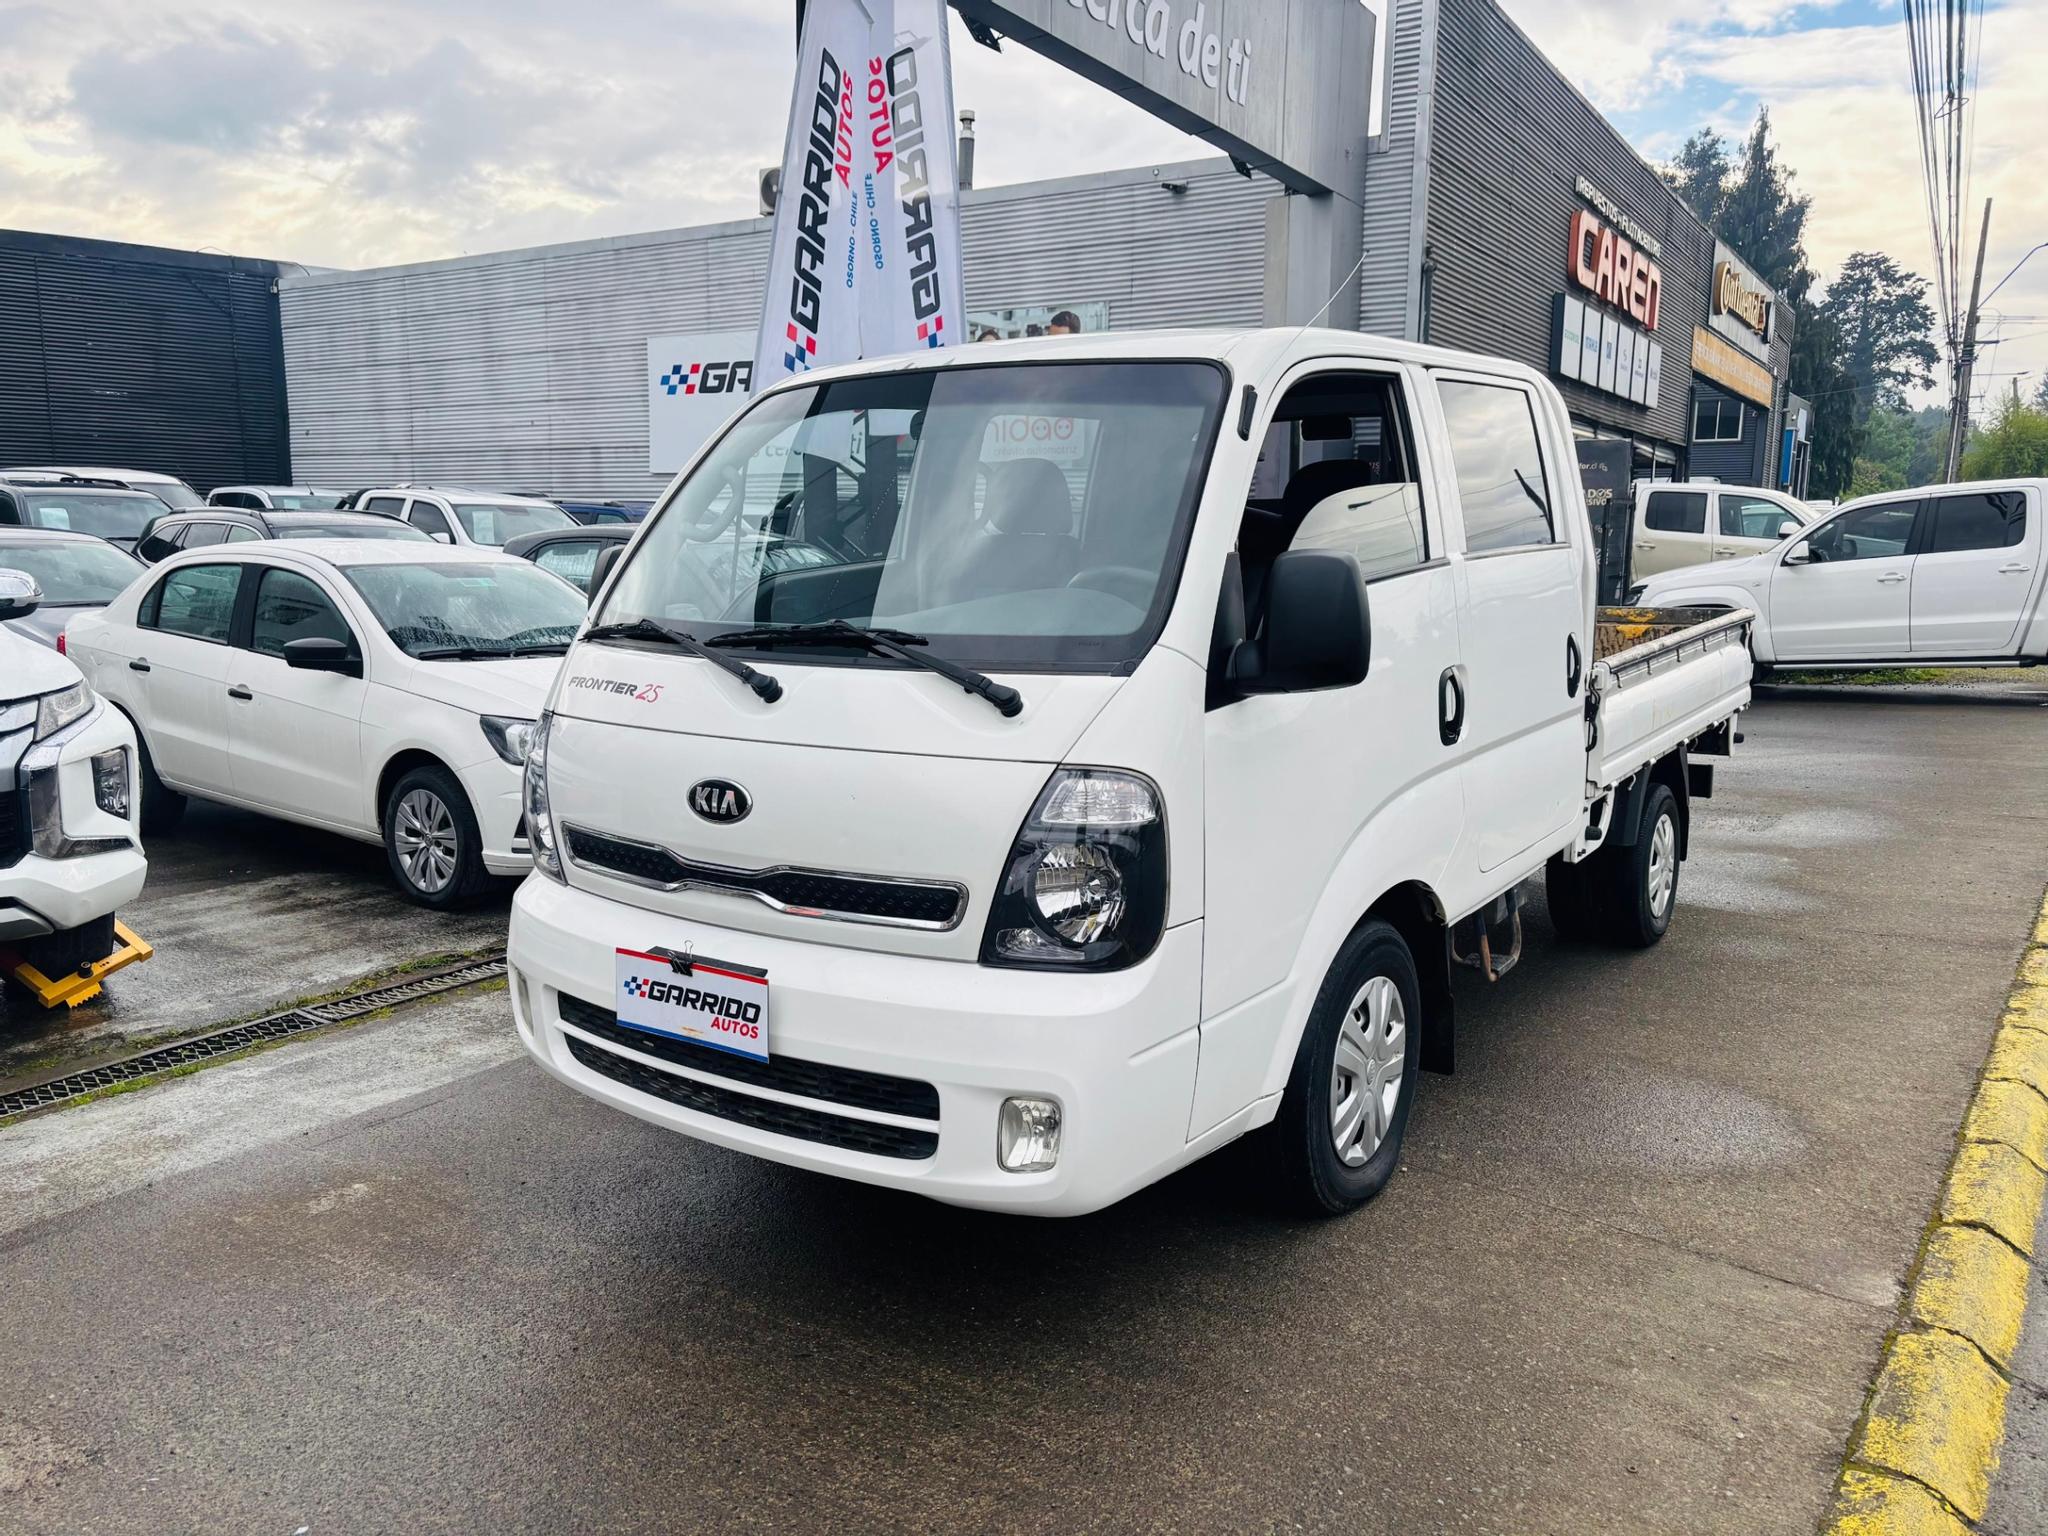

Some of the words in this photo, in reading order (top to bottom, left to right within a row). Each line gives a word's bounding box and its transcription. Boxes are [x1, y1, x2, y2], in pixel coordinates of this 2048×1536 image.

[1178, 0, 1221, 88] de
[1226, 38, 1252, 106] ti
[834, 69, 853, 190] AUTOS
[790, 46, 841, 335] GARRIDO
[850, 190, 858, 228] CHILE
[1576, 175, 1618, 224] REPUESTOS
[846, 238, 856, 289] OSORNO
[568, 675, 639, 698] FRONTIER
[694, 786, 740, 816] KIA
[648, 980, 762, 1025] GARRIDO
[710, 1016, 760, 1040] AUTOS
